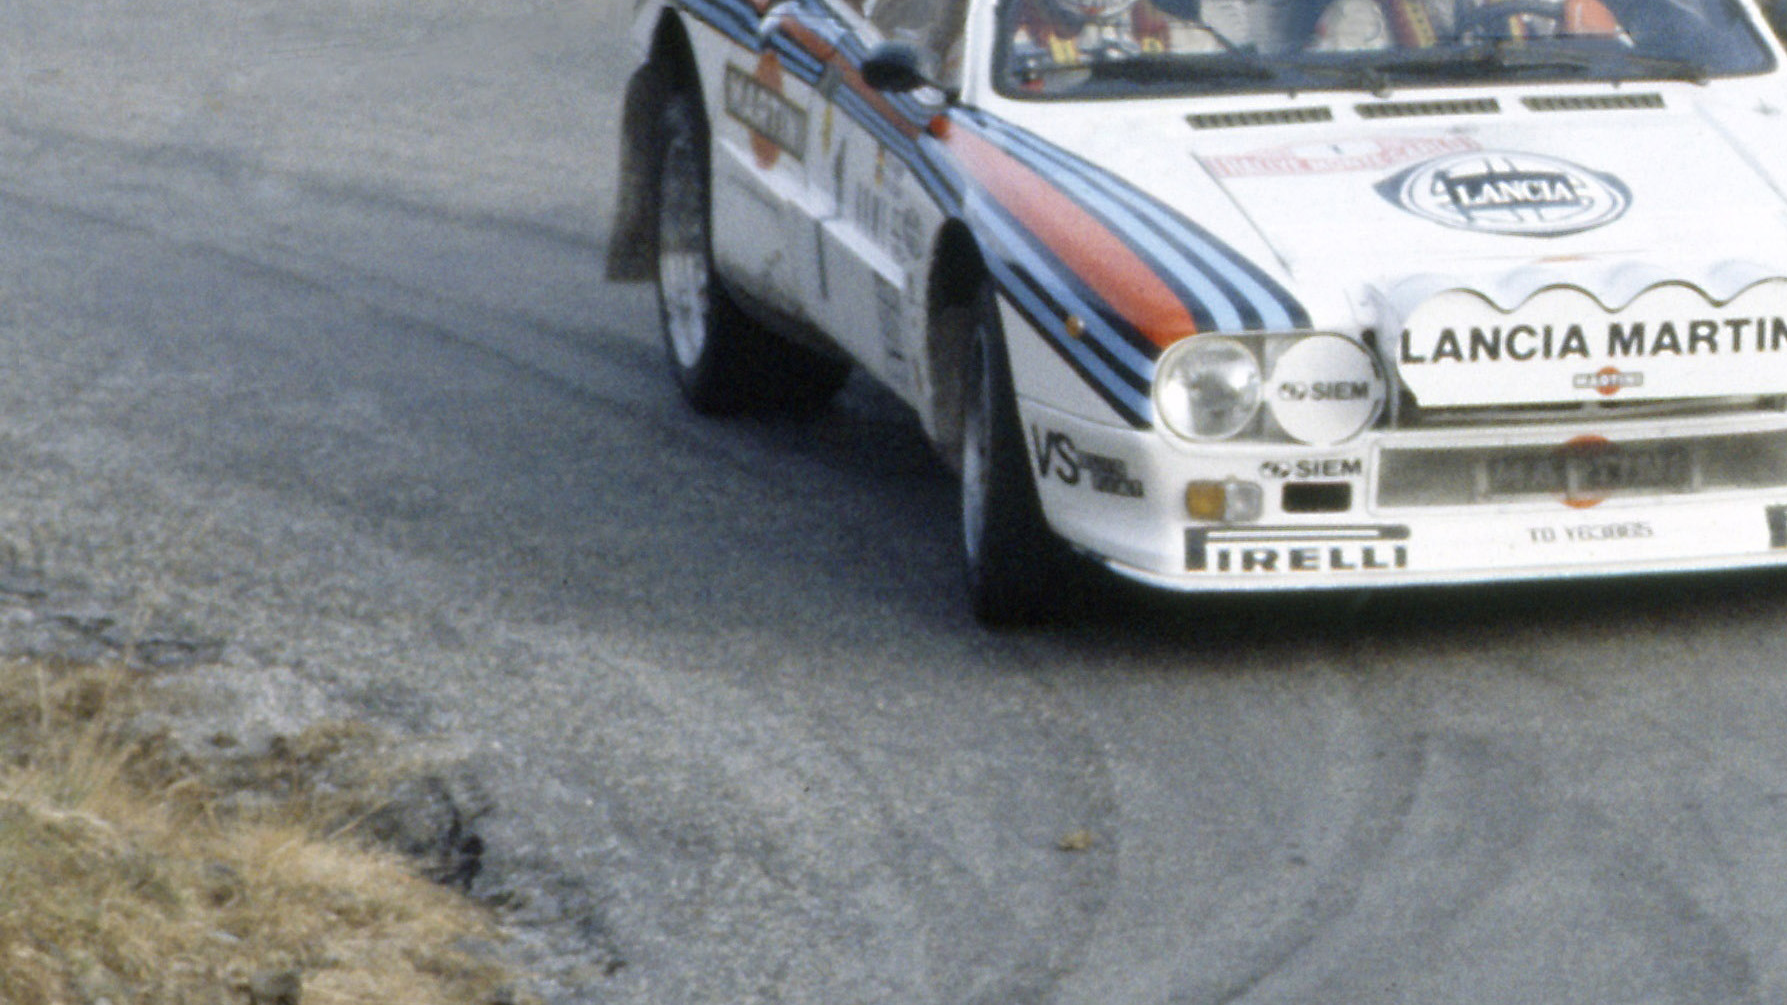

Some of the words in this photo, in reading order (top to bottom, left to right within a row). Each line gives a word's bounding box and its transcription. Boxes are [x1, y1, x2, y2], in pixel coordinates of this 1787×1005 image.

[1455, 178, 1574, 206] LANCIA
[1400, 323, 1590, 364] LANCIA
[1311, 381, 1369, 401] SIEM
[1030, 423, 1080, 487] VS
[1296, 458, 1363, 478] SIEM
[1184, 524, 1411, 572] PIRELLI
[1527, 527, 1557, 545] TO
